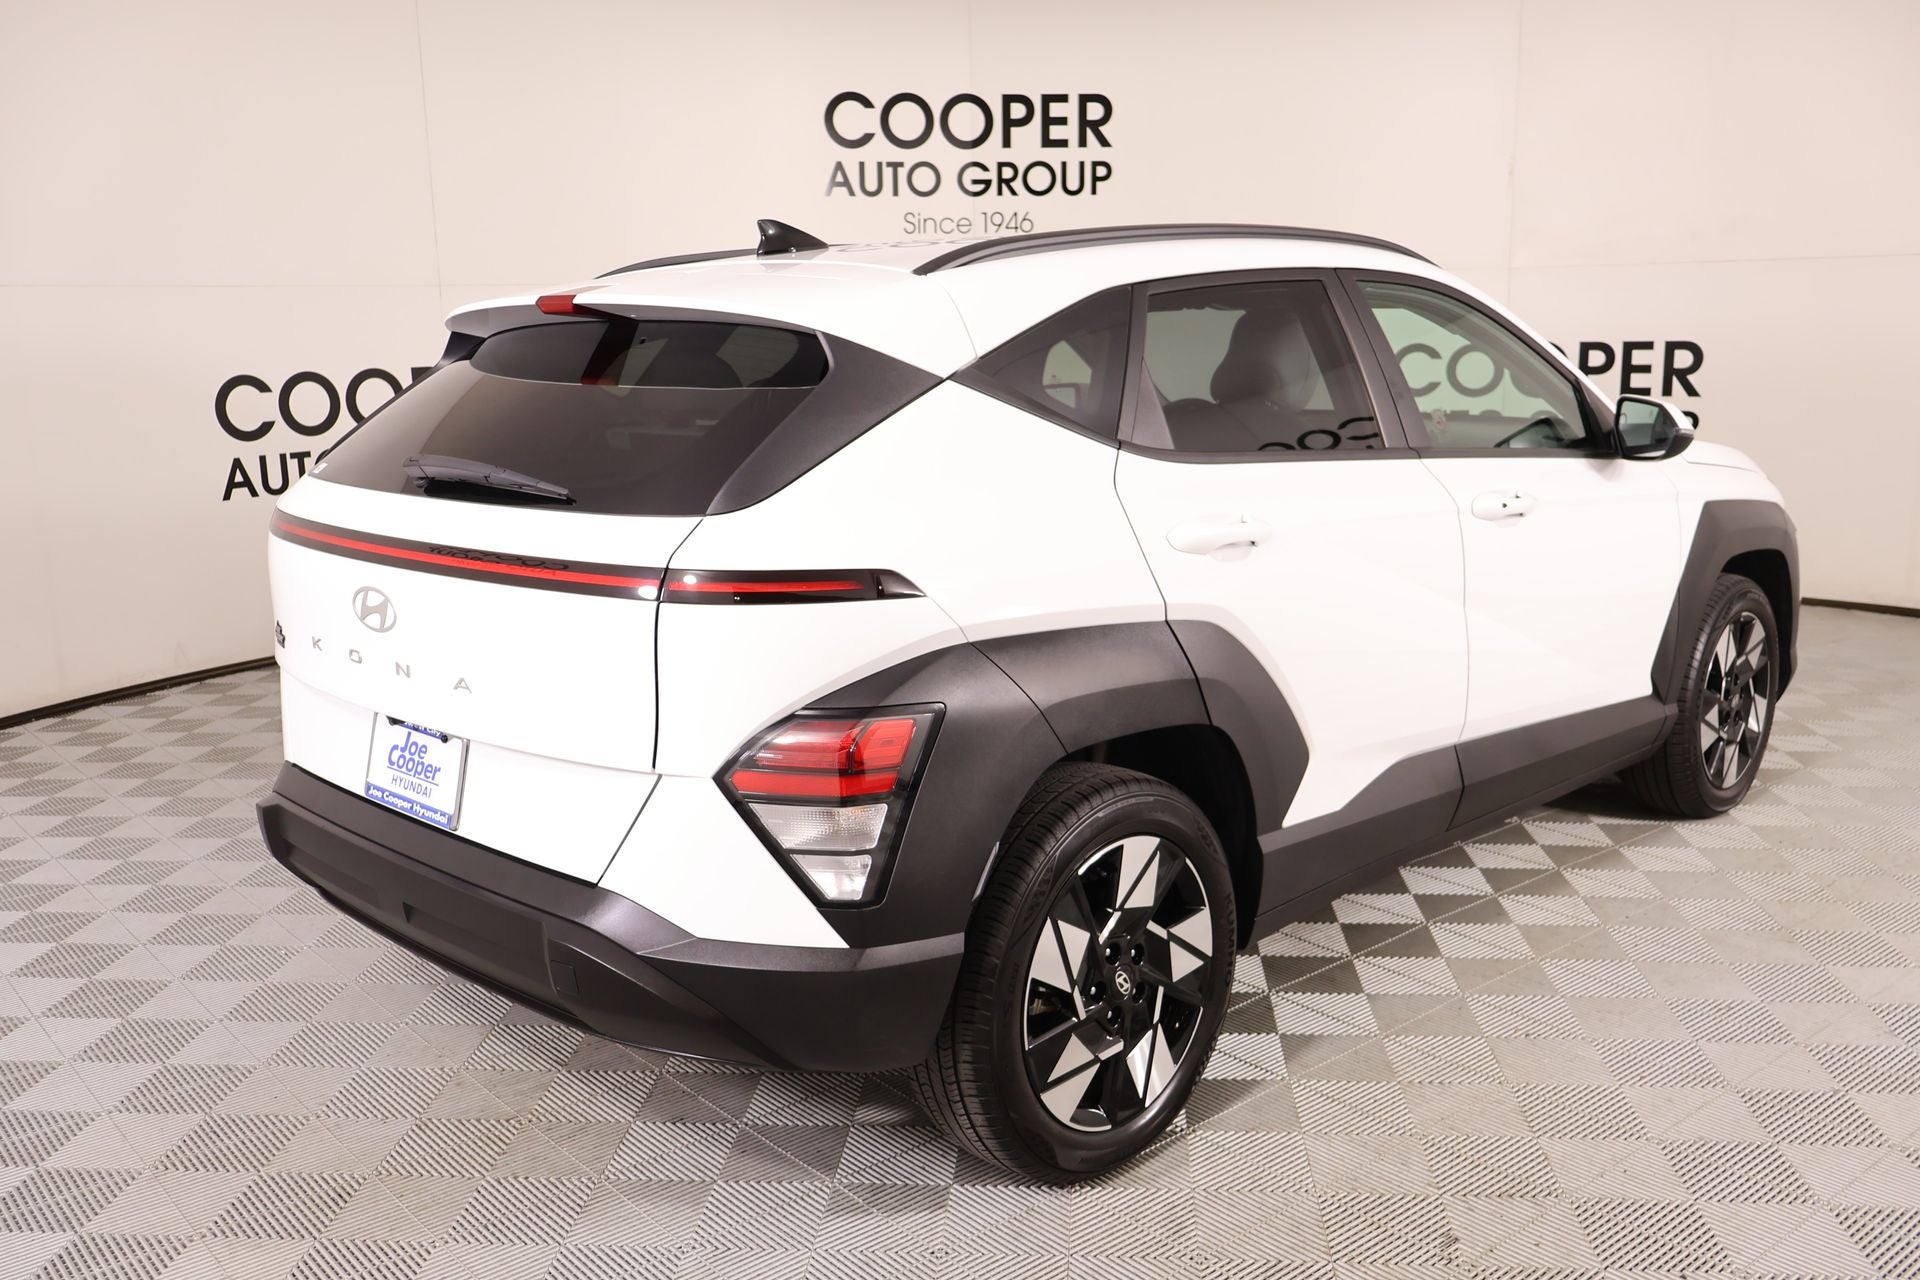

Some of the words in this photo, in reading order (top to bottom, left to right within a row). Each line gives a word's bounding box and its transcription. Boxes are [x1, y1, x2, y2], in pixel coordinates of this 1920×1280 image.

[824, 91, 1113, 150] COOPER
[824, 161, 941, 197] AUTO
[957, 161, 1112, 197] GROUP
[903, 212, 972, 234] Since
[981, 211, 1034, 233] 1946
[215, 367, 433, 442] COO
[222, 449, 329, 501] AUT
[311, 636, 473, 694] KONA
[388, 744, 441, 781] Cooper
[400, 731, 428, 759] Joe
[368, 785, 383, 798] Joe
[383, 791, 413, 810] Cooper
[413, 804, 448, 825] Hyundai
[391, 774, 432, 799] HYUNDAI
